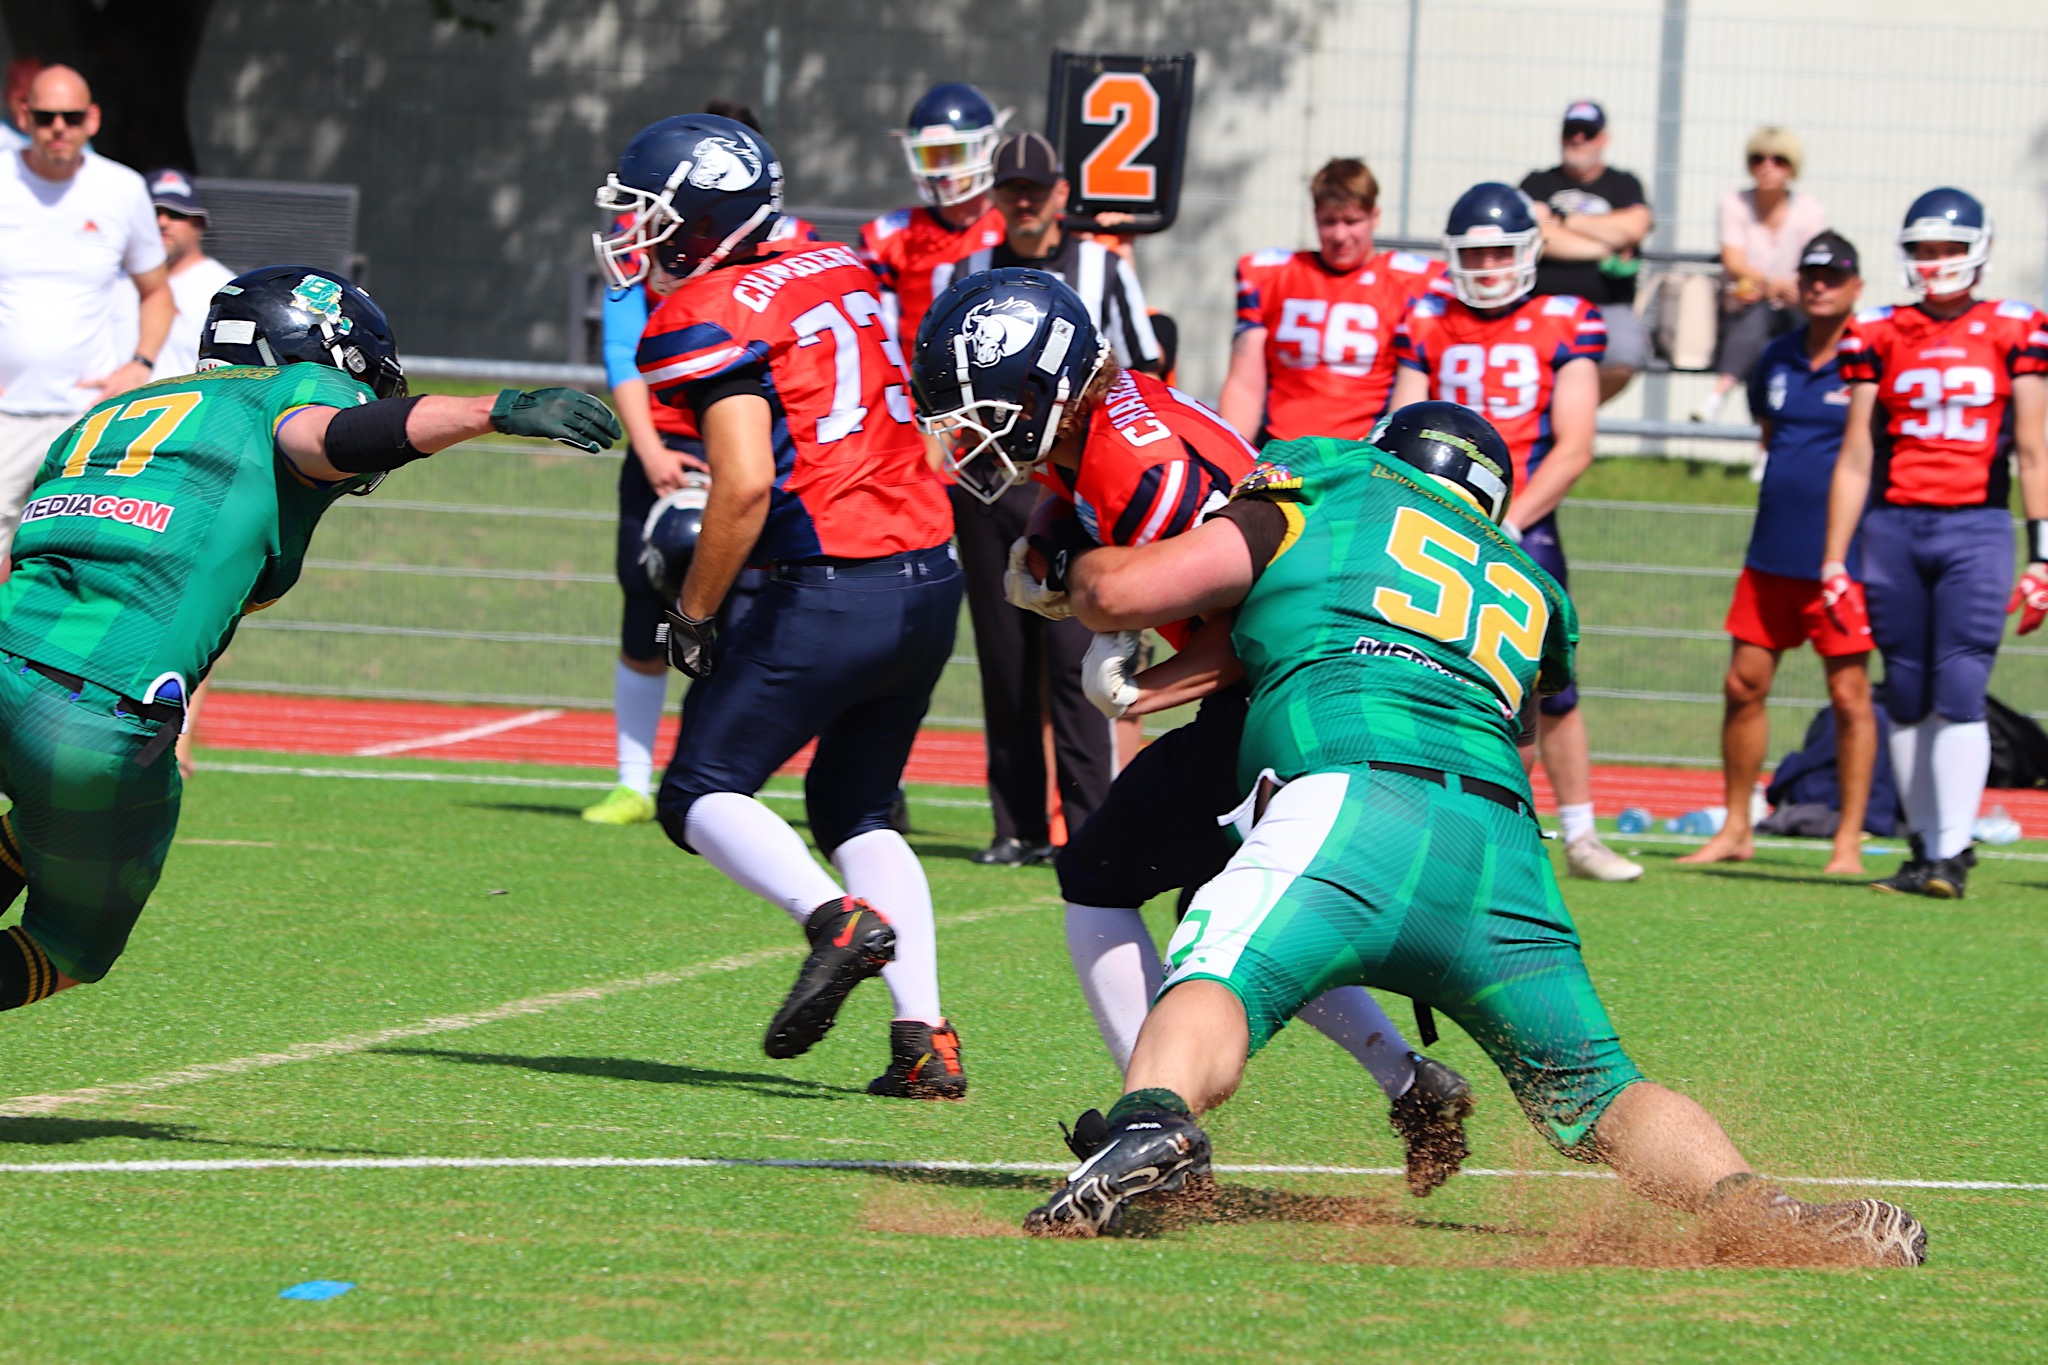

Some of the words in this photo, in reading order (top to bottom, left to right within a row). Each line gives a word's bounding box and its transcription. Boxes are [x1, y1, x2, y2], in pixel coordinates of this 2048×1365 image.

[1081, 71, 1160, 201] 2
[790, 289, 913, 445] 73
[1275, 297, 1379, 378] 56
[1437, 344, 1541, 421] 83
[1893, 365, 1996, 443] 32
[61, 391, 203, 478] 17
[1371, 505, 1551, 716] 52
